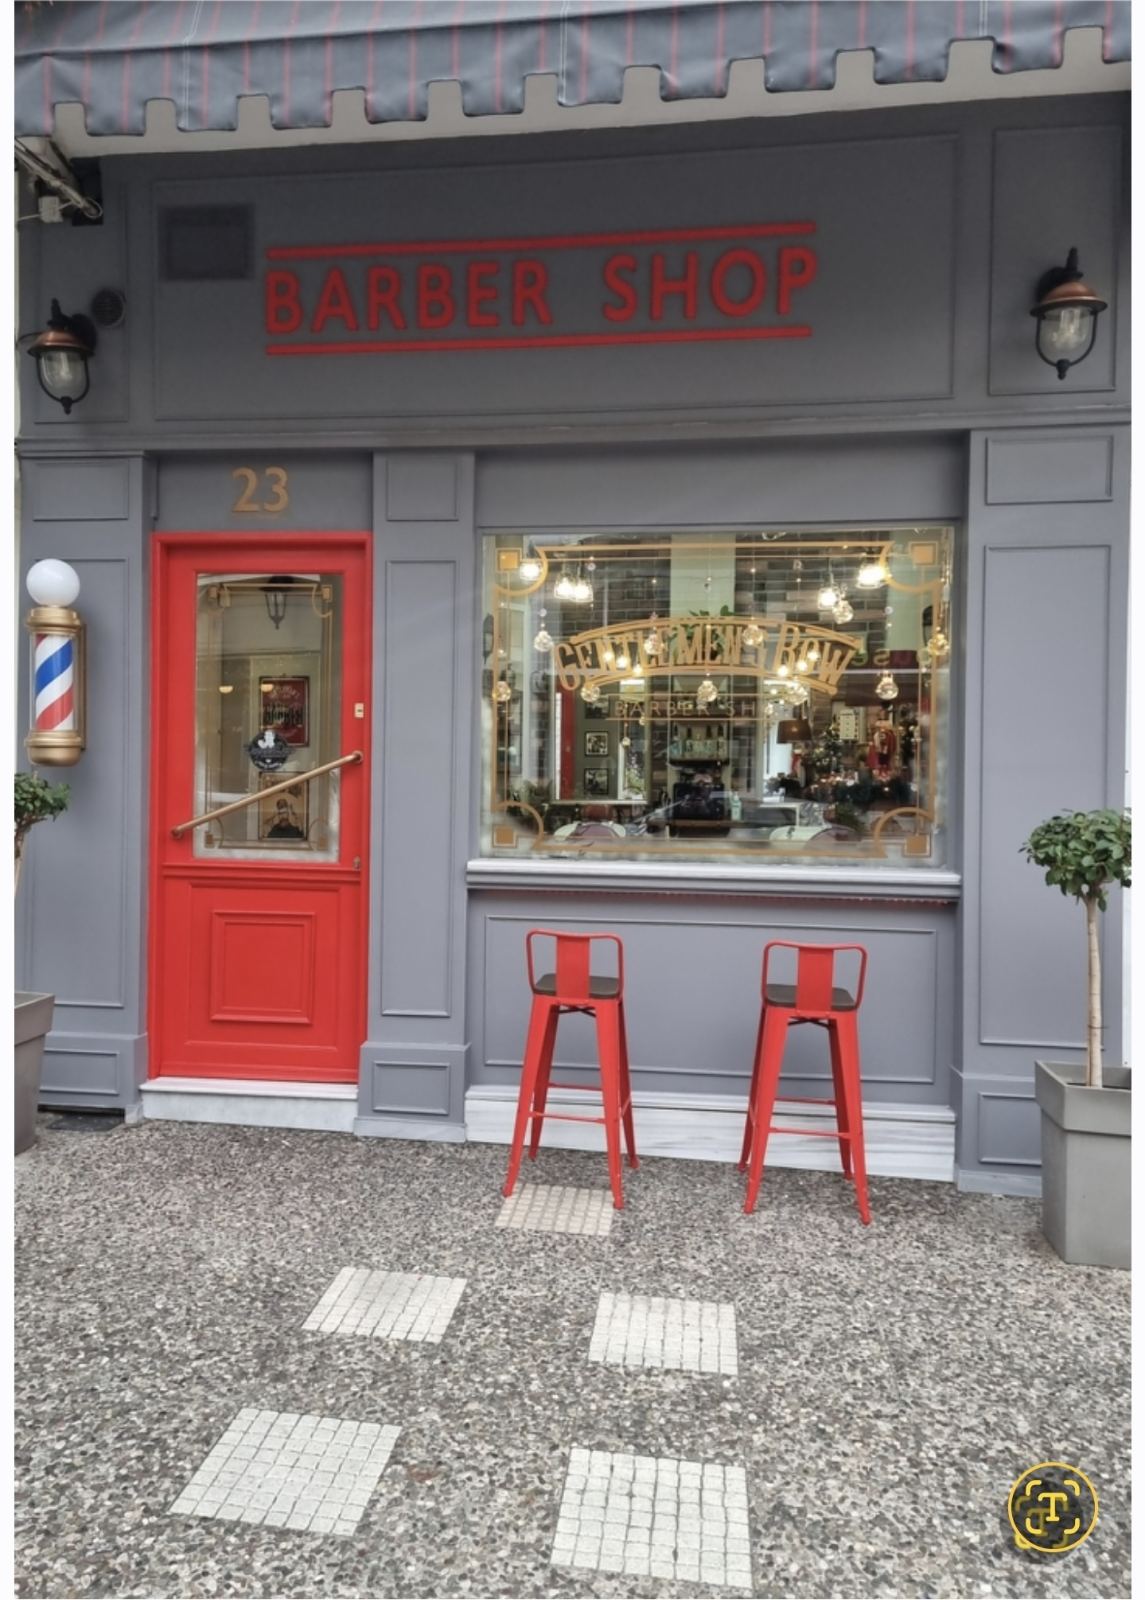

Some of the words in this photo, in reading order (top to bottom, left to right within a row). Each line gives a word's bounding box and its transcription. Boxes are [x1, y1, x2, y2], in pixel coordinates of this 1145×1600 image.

[266, 260, 553, 335] BARBER
[601, 246, 818, 323] SHOP
[231, 466, 289, 513] 23
[613, 701, 711, 717] BARBER
